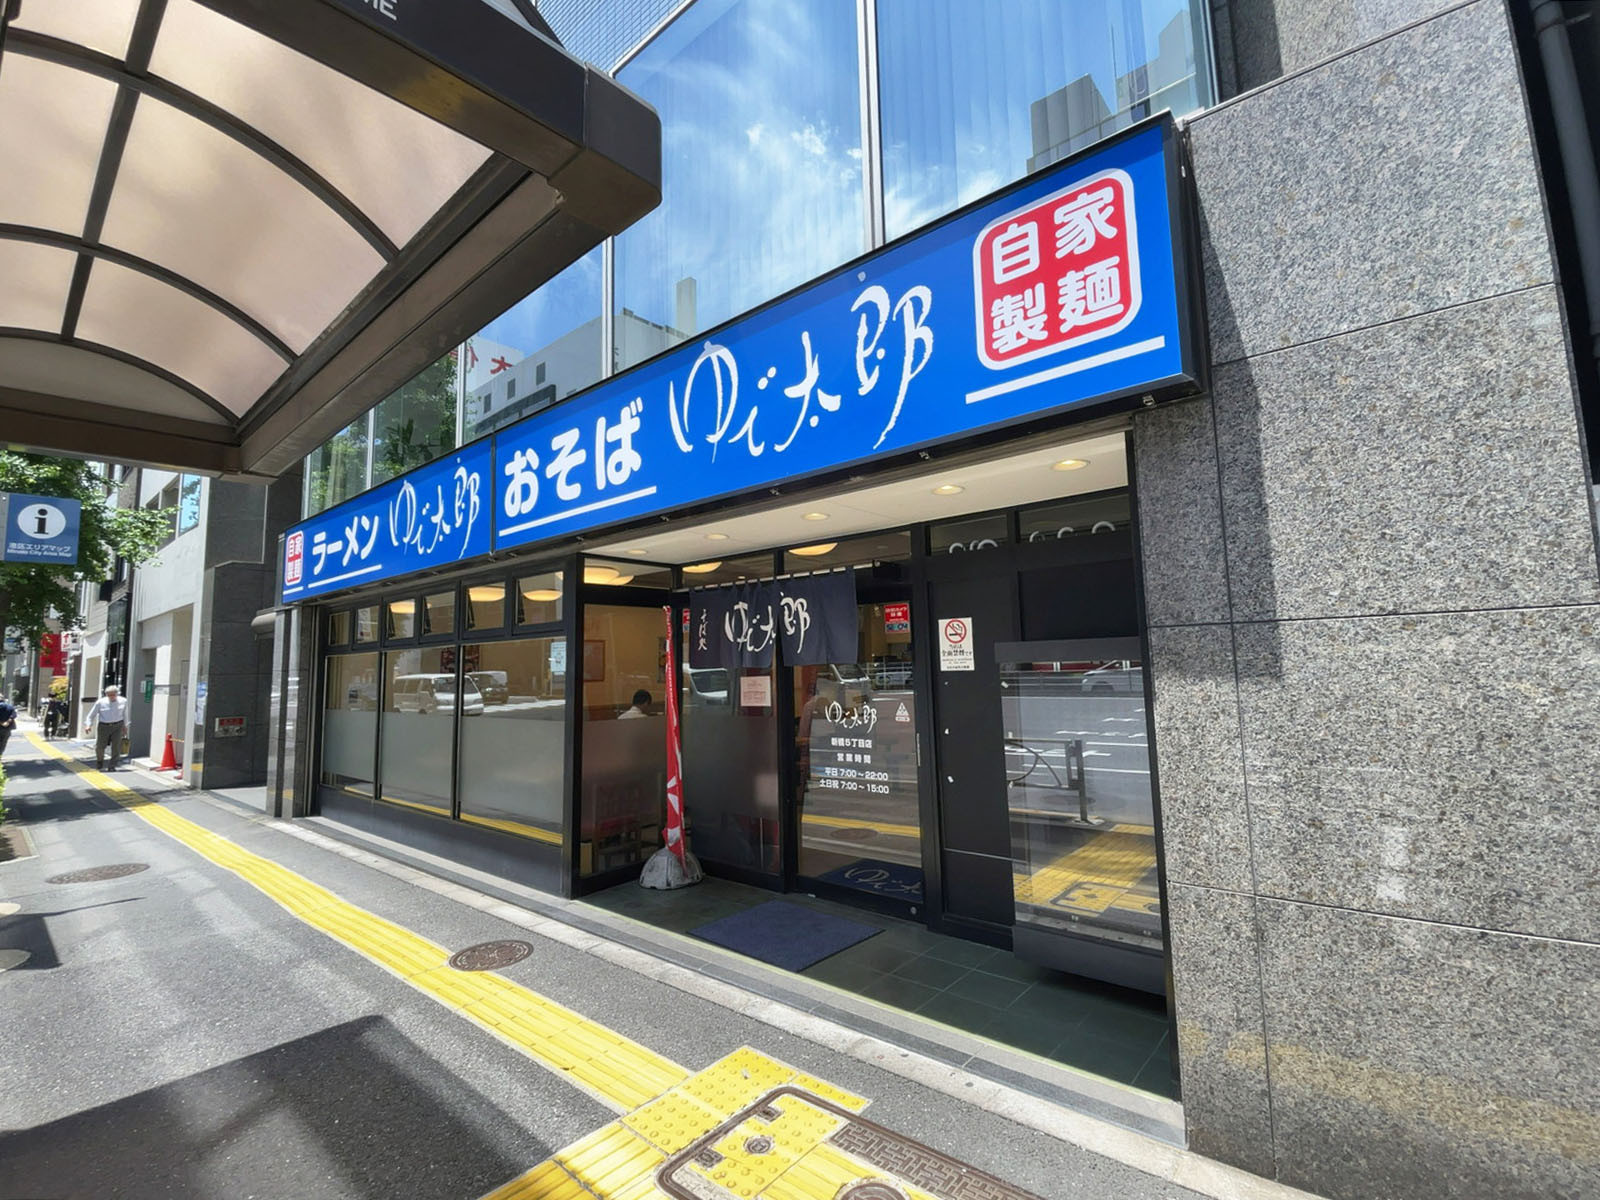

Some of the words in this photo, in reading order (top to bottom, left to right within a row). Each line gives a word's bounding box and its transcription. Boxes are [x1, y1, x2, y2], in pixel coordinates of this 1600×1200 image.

[993, 185, 1118, 284] 自家
[991, 255, 1123, 353] 製麺
[504, 397, 643, 518] おそば
[312, 515, 379, 575] ラーメン
